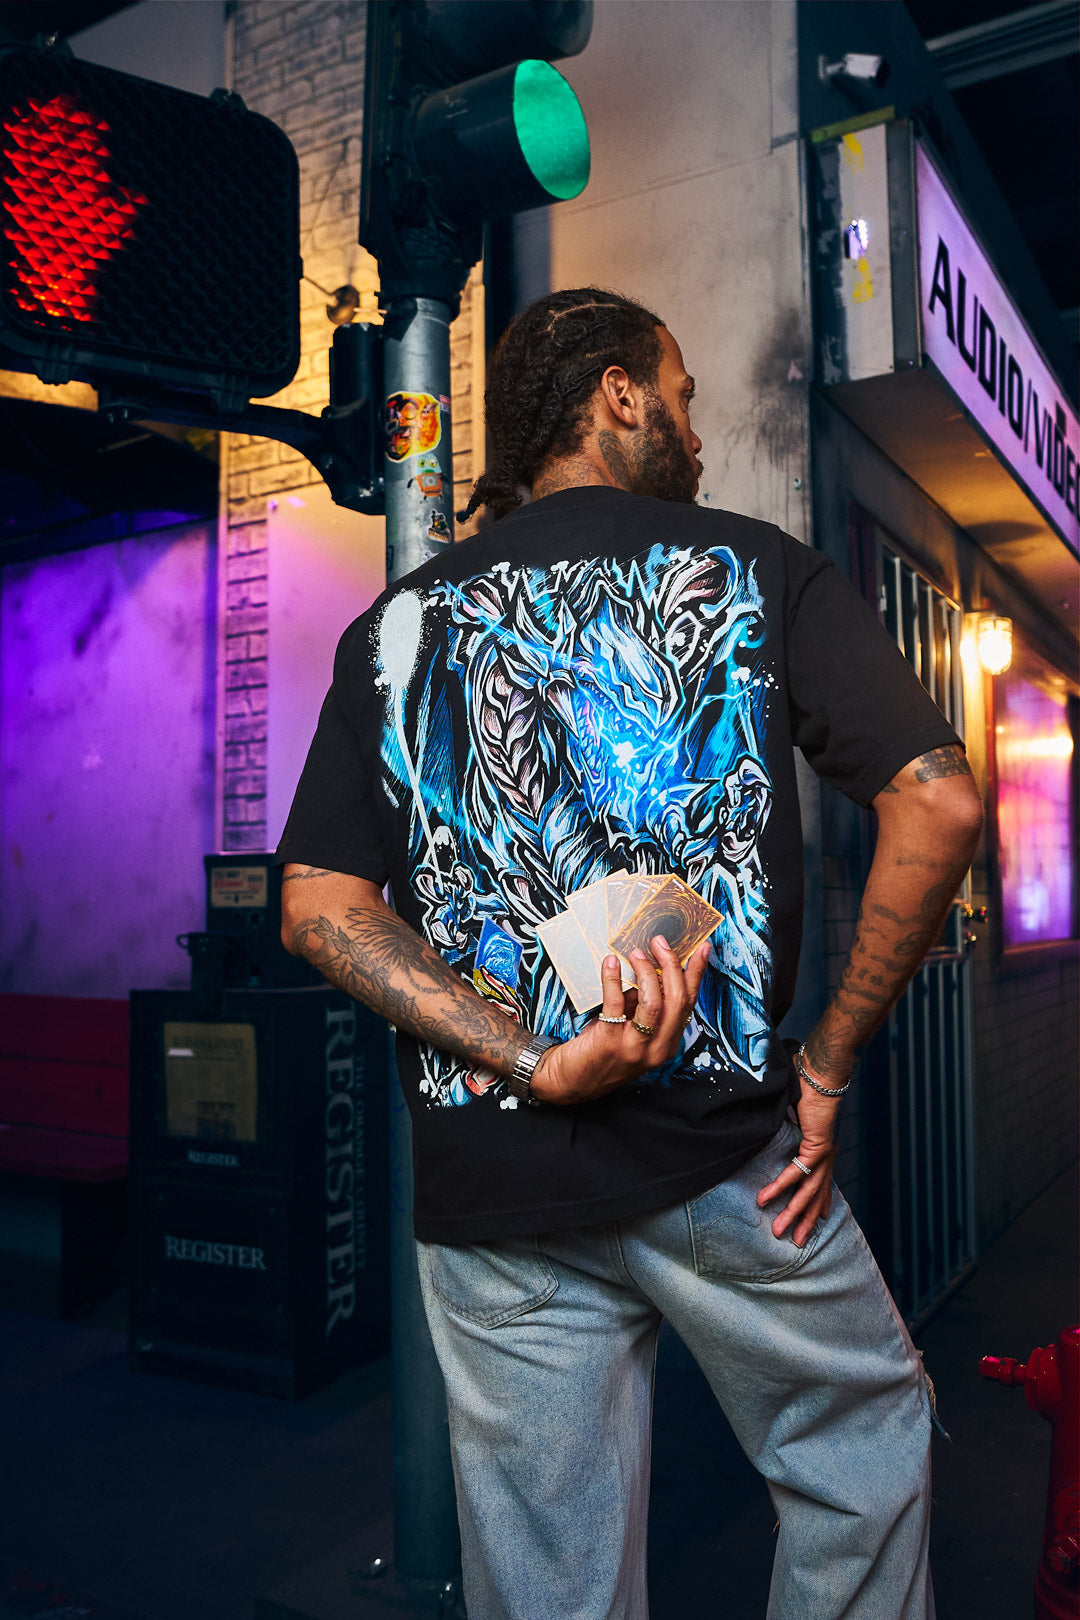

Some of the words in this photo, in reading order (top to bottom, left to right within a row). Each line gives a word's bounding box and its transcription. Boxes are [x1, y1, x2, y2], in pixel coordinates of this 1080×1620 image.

[930, 235, 1080, 520] AUDIO/VIDE
[164, 1235, 266, 1270] REGISTER
[326, 1003, 357, 1337] REGISTER
